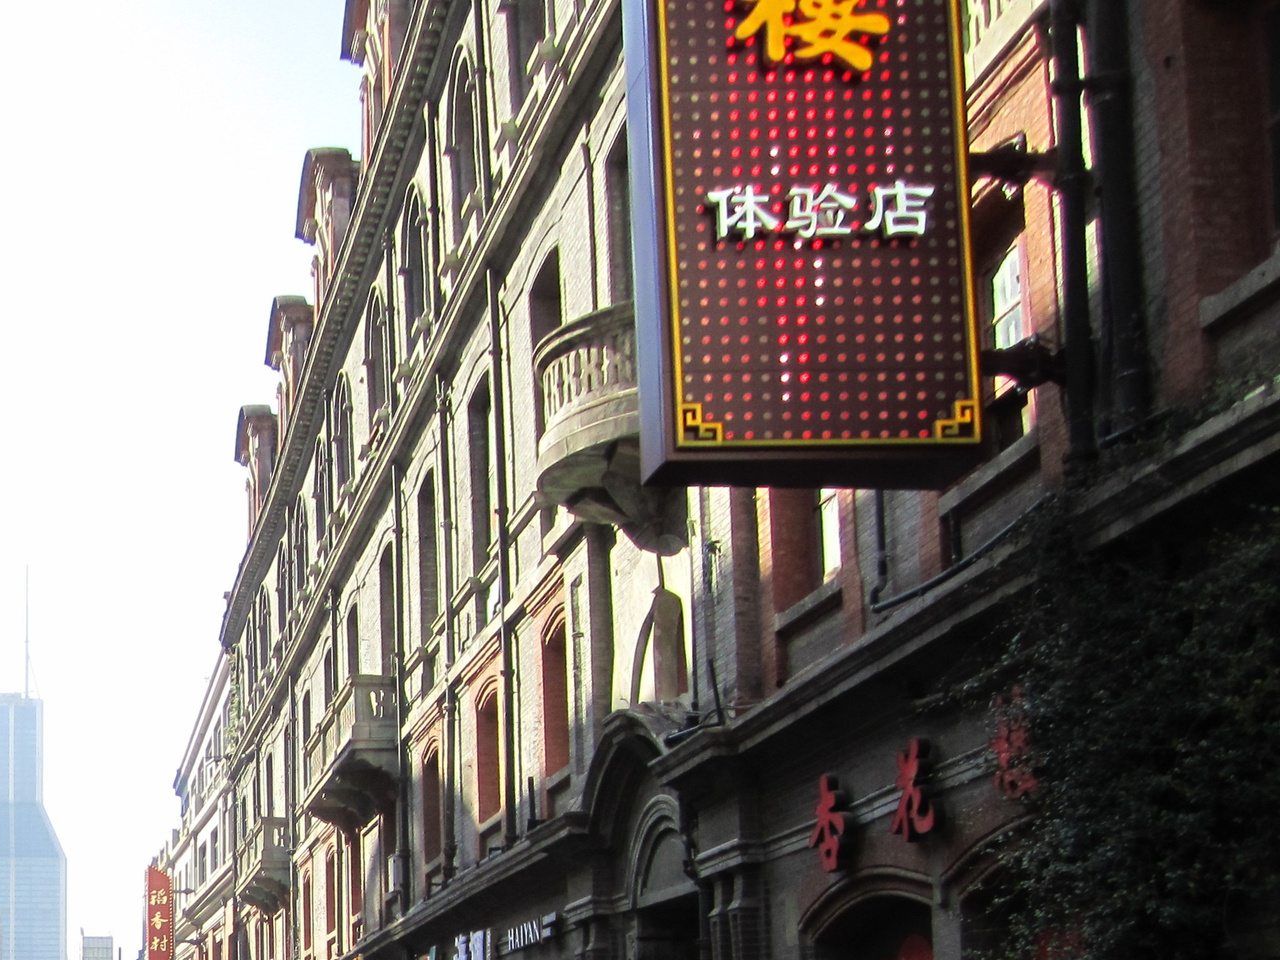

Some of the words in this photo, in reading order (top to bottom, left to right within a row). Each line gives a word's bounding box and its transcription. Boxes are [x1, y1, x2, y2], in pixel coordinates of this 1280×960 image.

[706, 180, 935, 239] 体验店
[149, 889, 169, 953] 稻香村
[508, 918, 540, 951] HAIYAN
